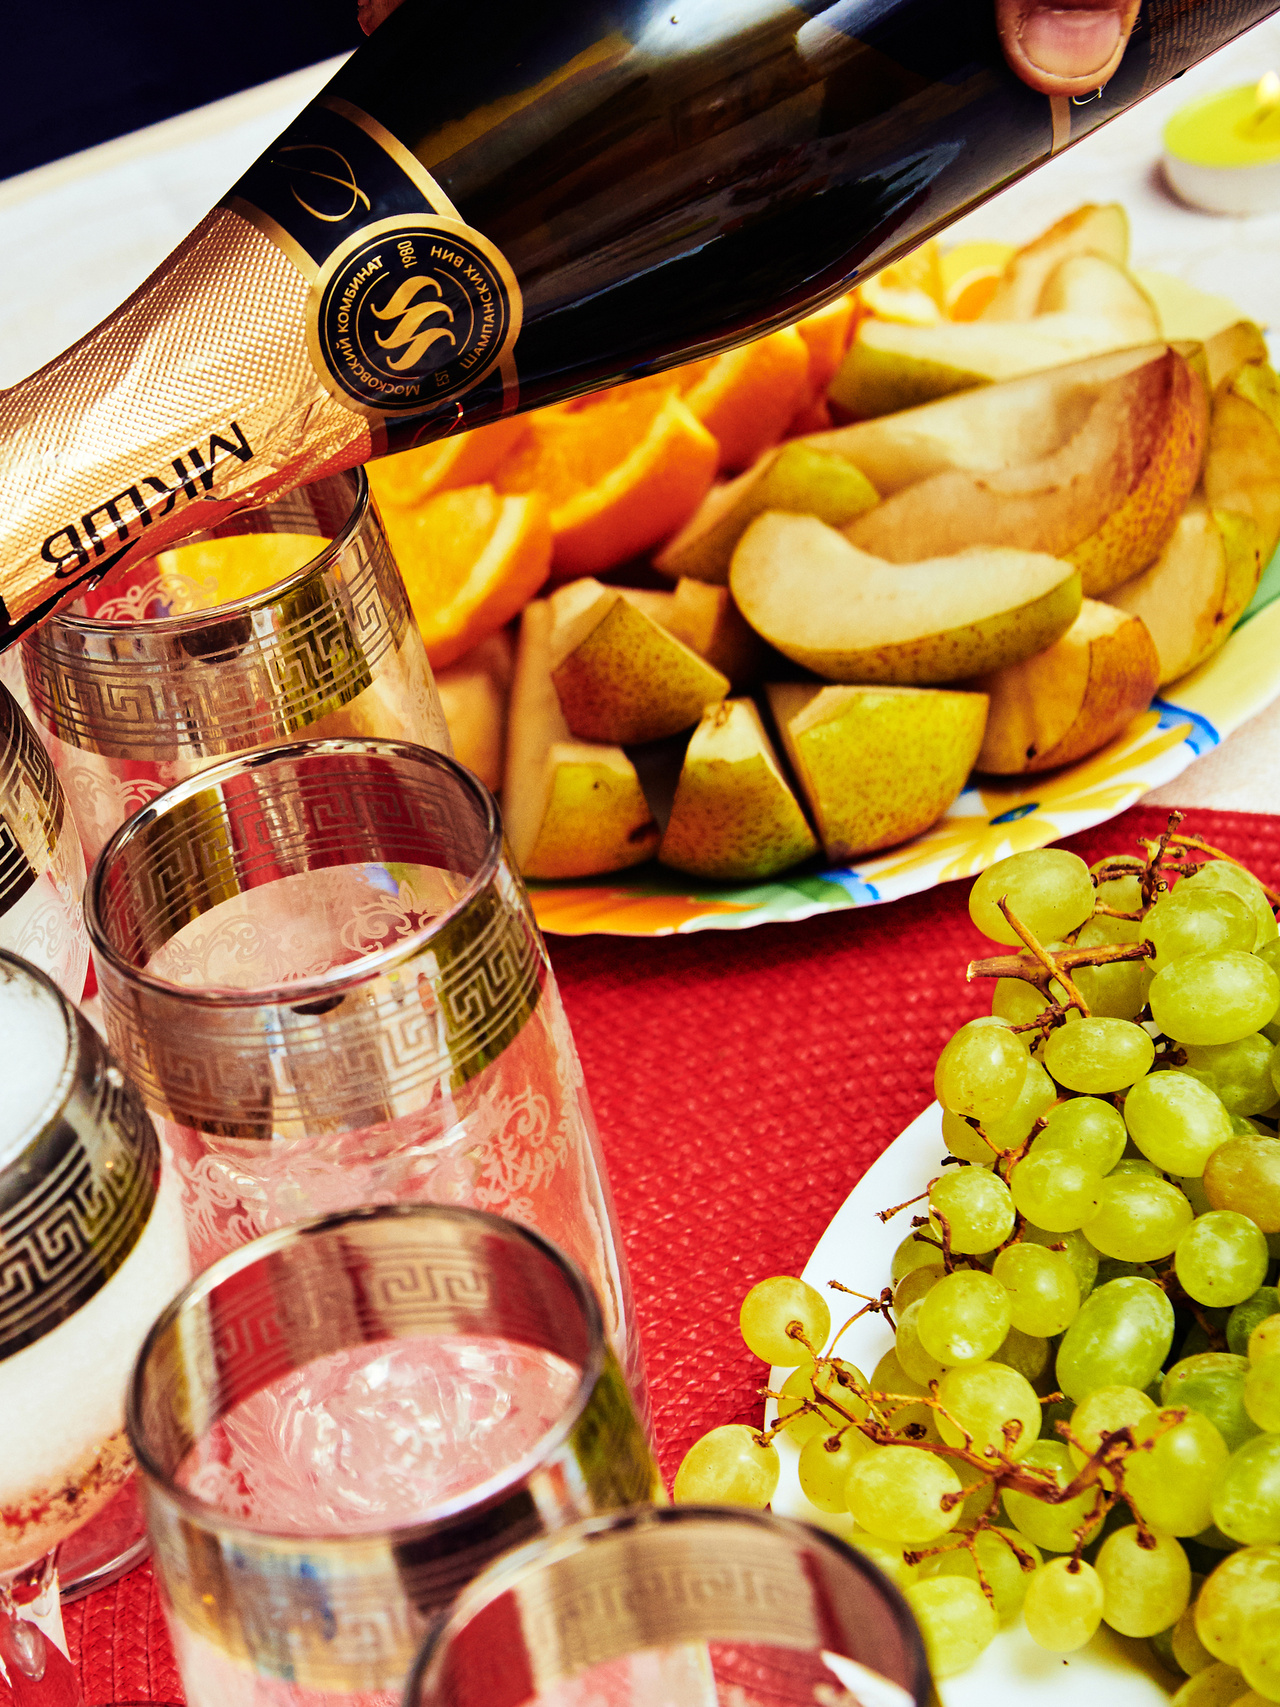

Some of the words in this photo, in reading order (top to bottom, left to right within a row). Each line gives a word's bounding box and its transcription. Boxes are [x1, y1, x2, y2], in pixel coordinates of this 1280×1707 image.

[397, 240, 418, 269] 1980
[430, 245, 465, 269] ВИН
[337, 255, 383, 333] КОМБИНАТ
[460, 264, 495, 370] ШАМПАНСКИХ
[41, 421, 254, 579] МКШВ
